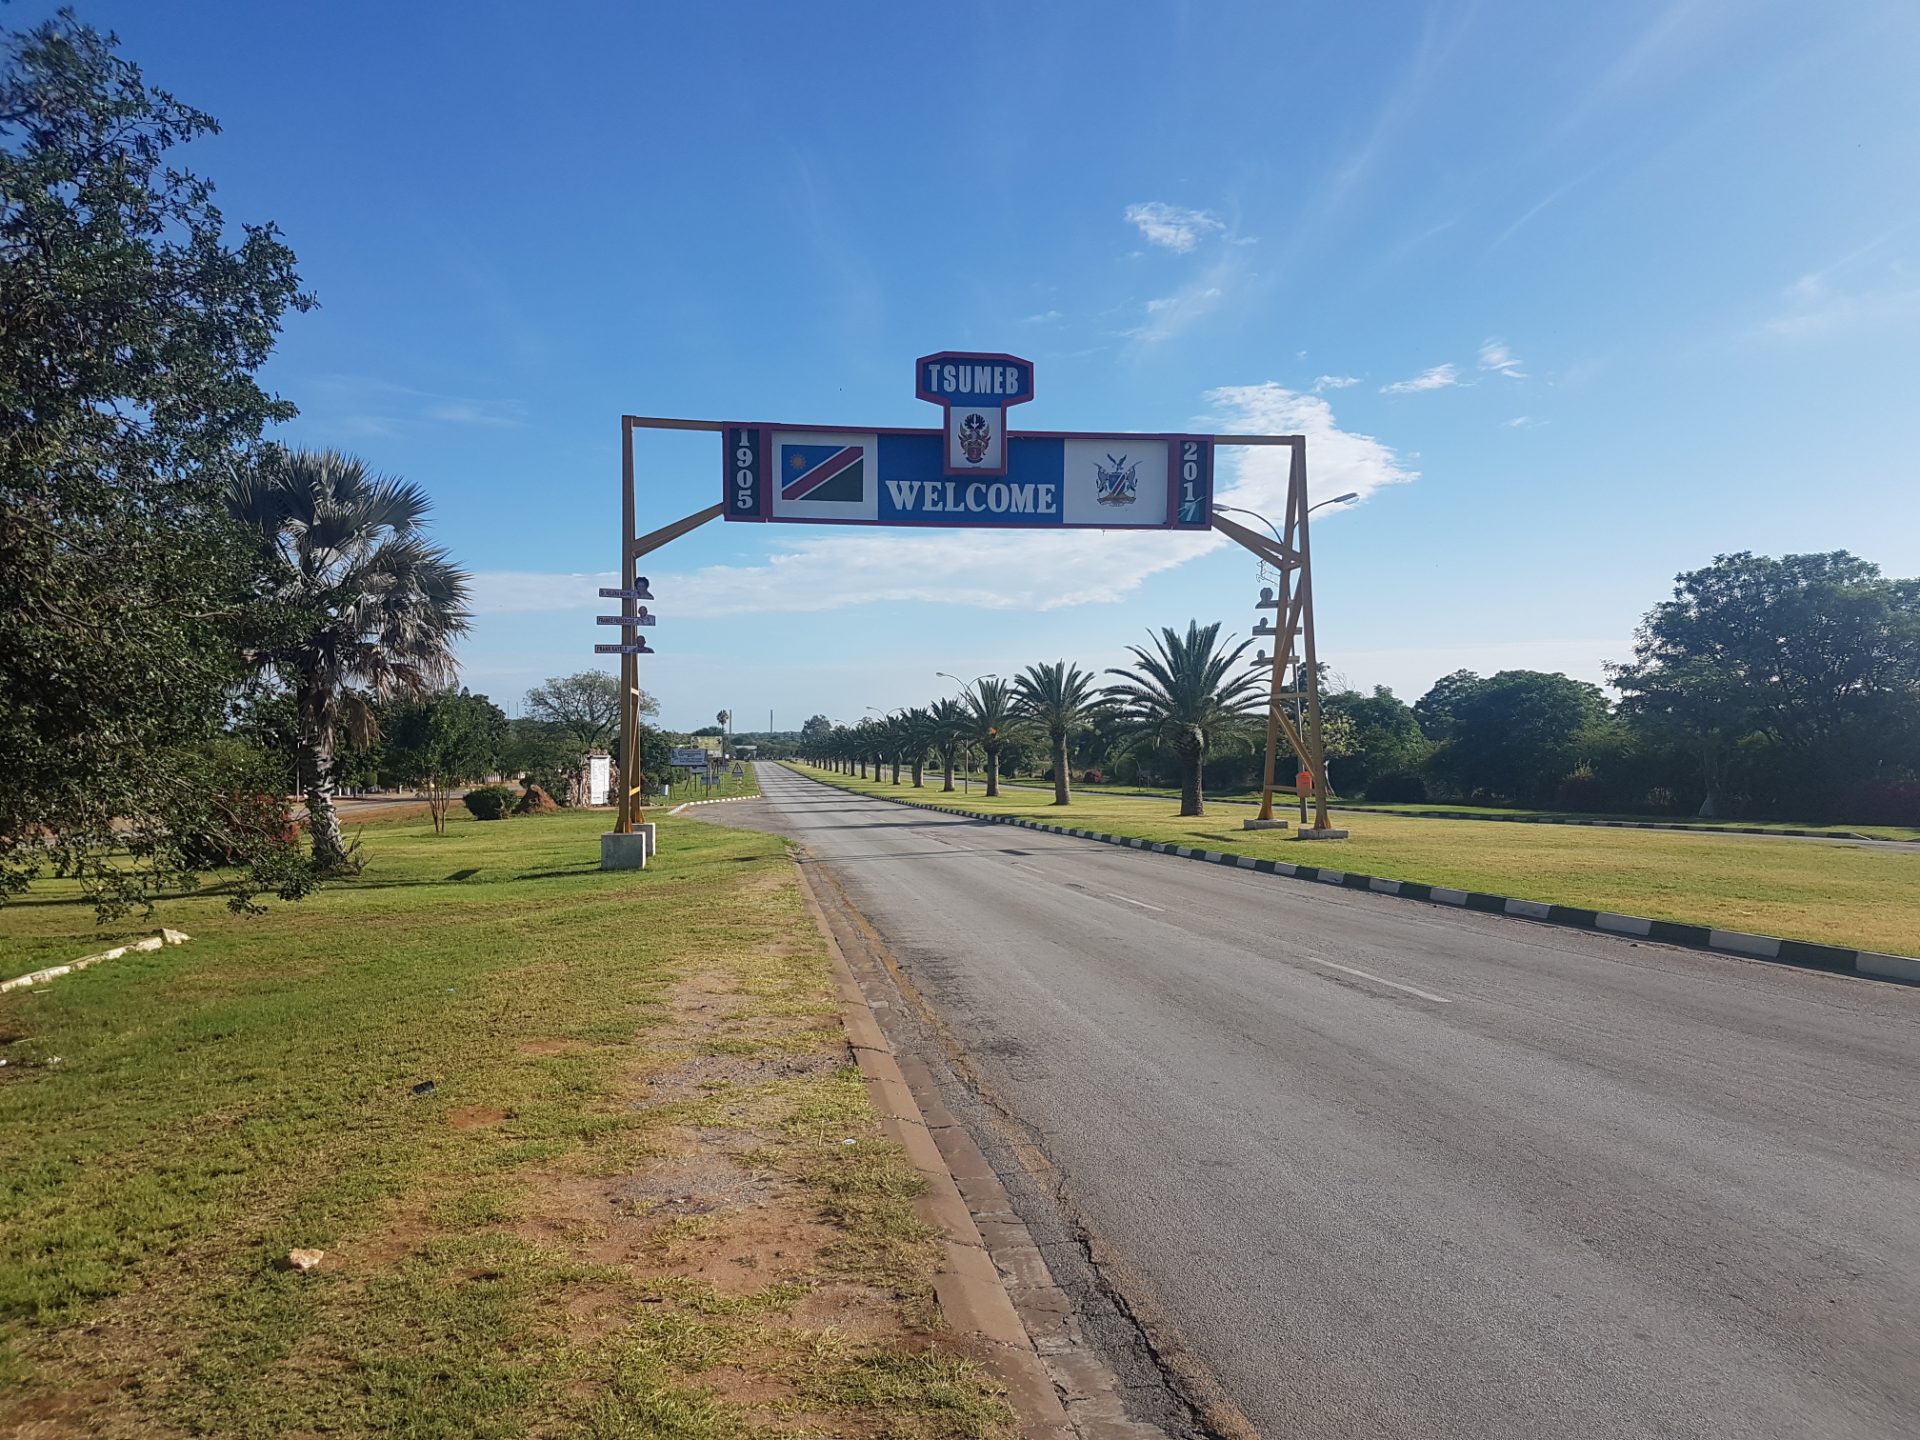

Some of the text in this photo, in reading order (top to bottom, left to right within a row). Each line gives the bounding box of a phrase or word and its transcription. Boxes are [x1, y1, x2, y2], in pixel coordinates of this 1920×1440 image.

[929, 364, 1018, 394] TSUMEB
[736, 430, 753, 509] 1905
[885, 480, 1057, 514] WELCOME
[1183, 441, 1198, 522] 2017
